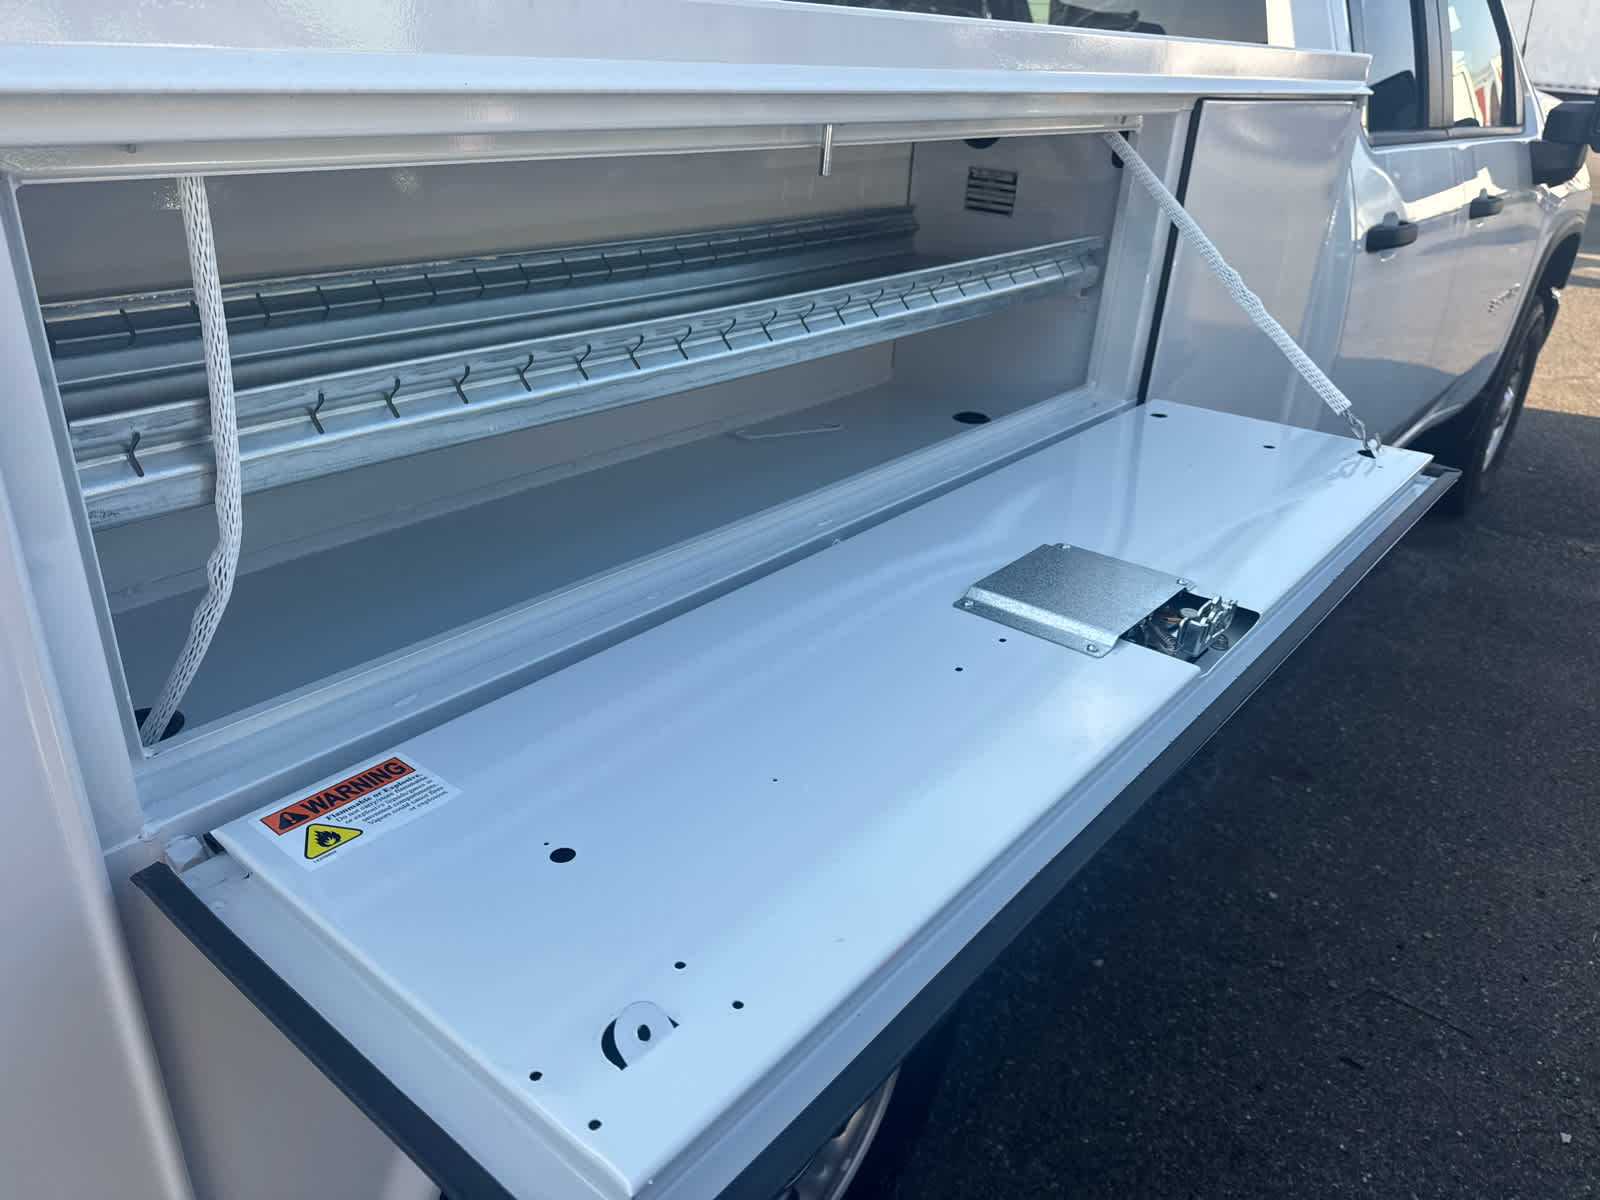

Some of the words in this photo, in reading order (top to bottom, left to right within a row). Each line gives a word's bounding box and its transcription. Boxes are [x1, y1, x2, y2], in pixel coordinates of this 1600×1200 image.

[301, 762, 407, 814] WARNING
[324, 795, 373, 820] Flammable
[334, 814, 349, 822] Do
